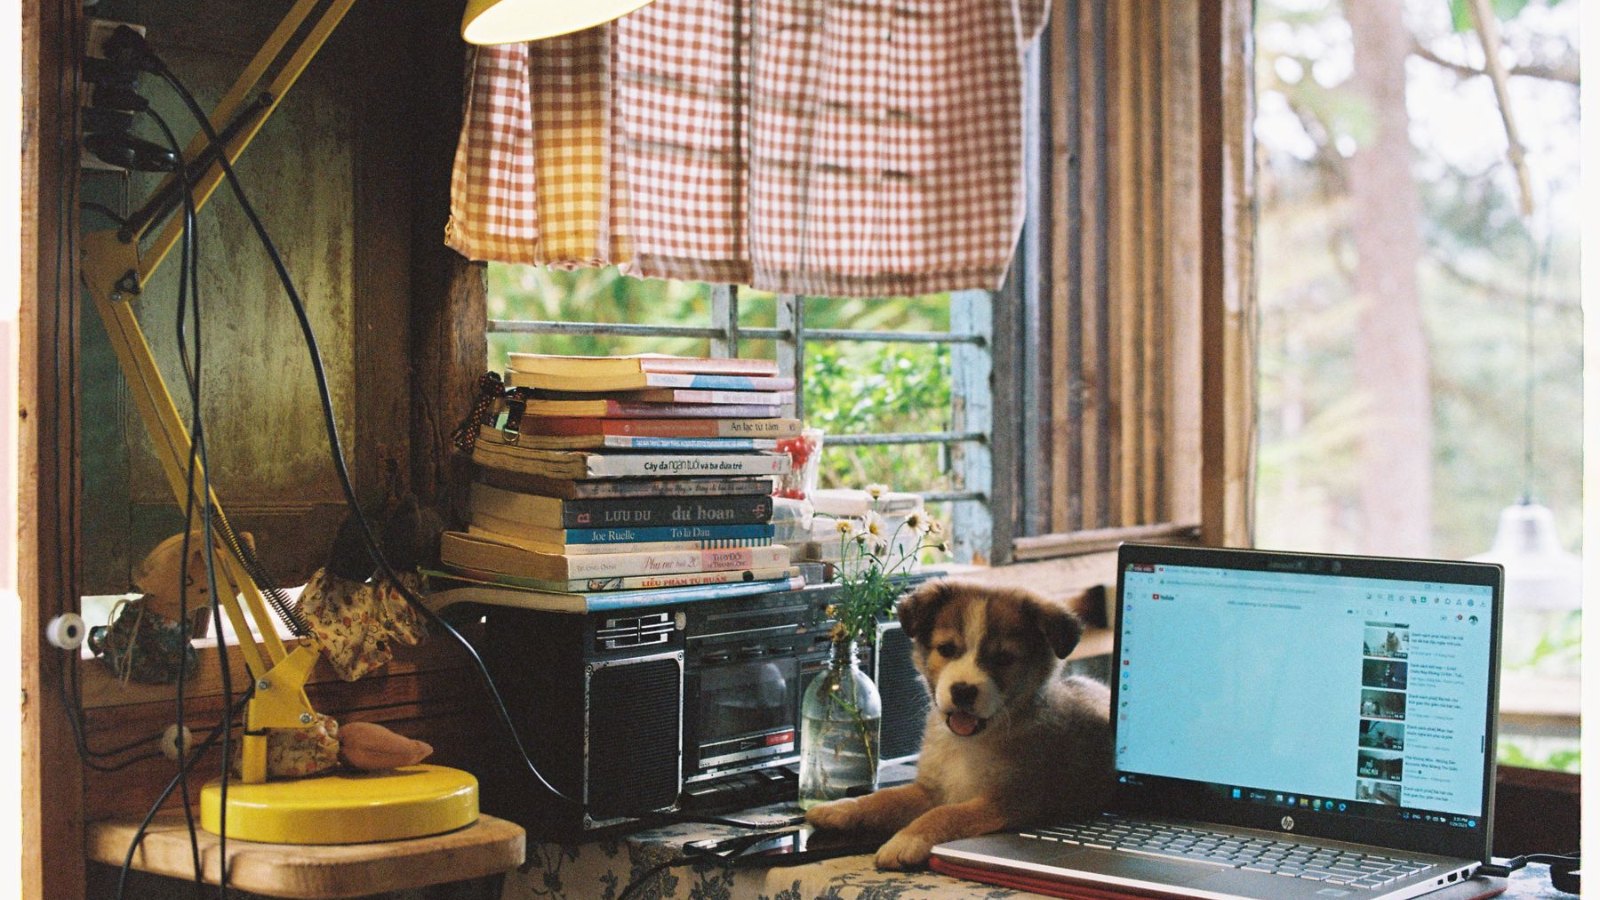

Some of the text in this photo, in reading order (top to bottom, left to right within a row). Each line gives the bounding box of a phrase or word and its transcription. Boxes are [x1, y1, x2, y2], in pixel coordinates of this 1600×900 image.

[697, 504, 734, 520] hoan
[591, 530, 635, 541] Joe Ruelle
[1281, 815, 1295, 831] hp
